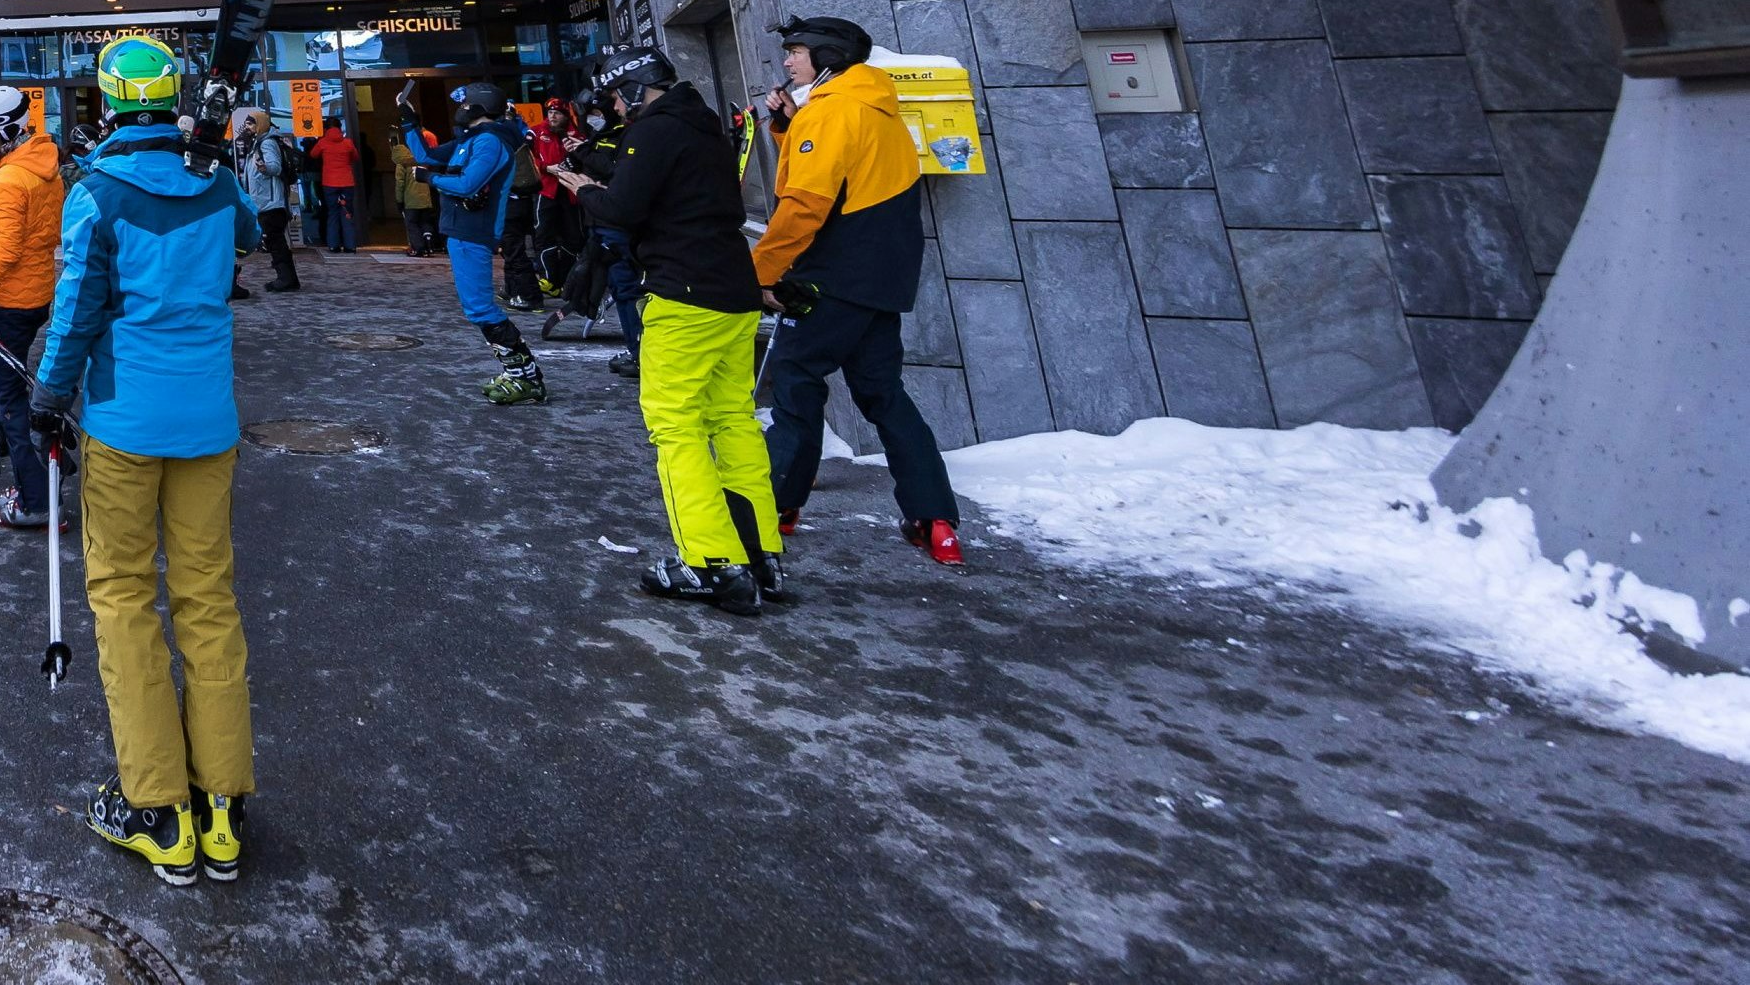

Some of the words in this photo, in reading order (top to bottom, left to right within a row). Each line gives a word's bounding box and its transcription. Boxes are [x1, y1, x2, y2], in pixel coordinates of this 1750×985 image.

[357, 17, 462, 33] SCHISCHULE
[64, 27, 180, 44] KASSA/TICKETS
[600, 54, 656, 86] uvex
[292, 82, 319, 92] 2G
